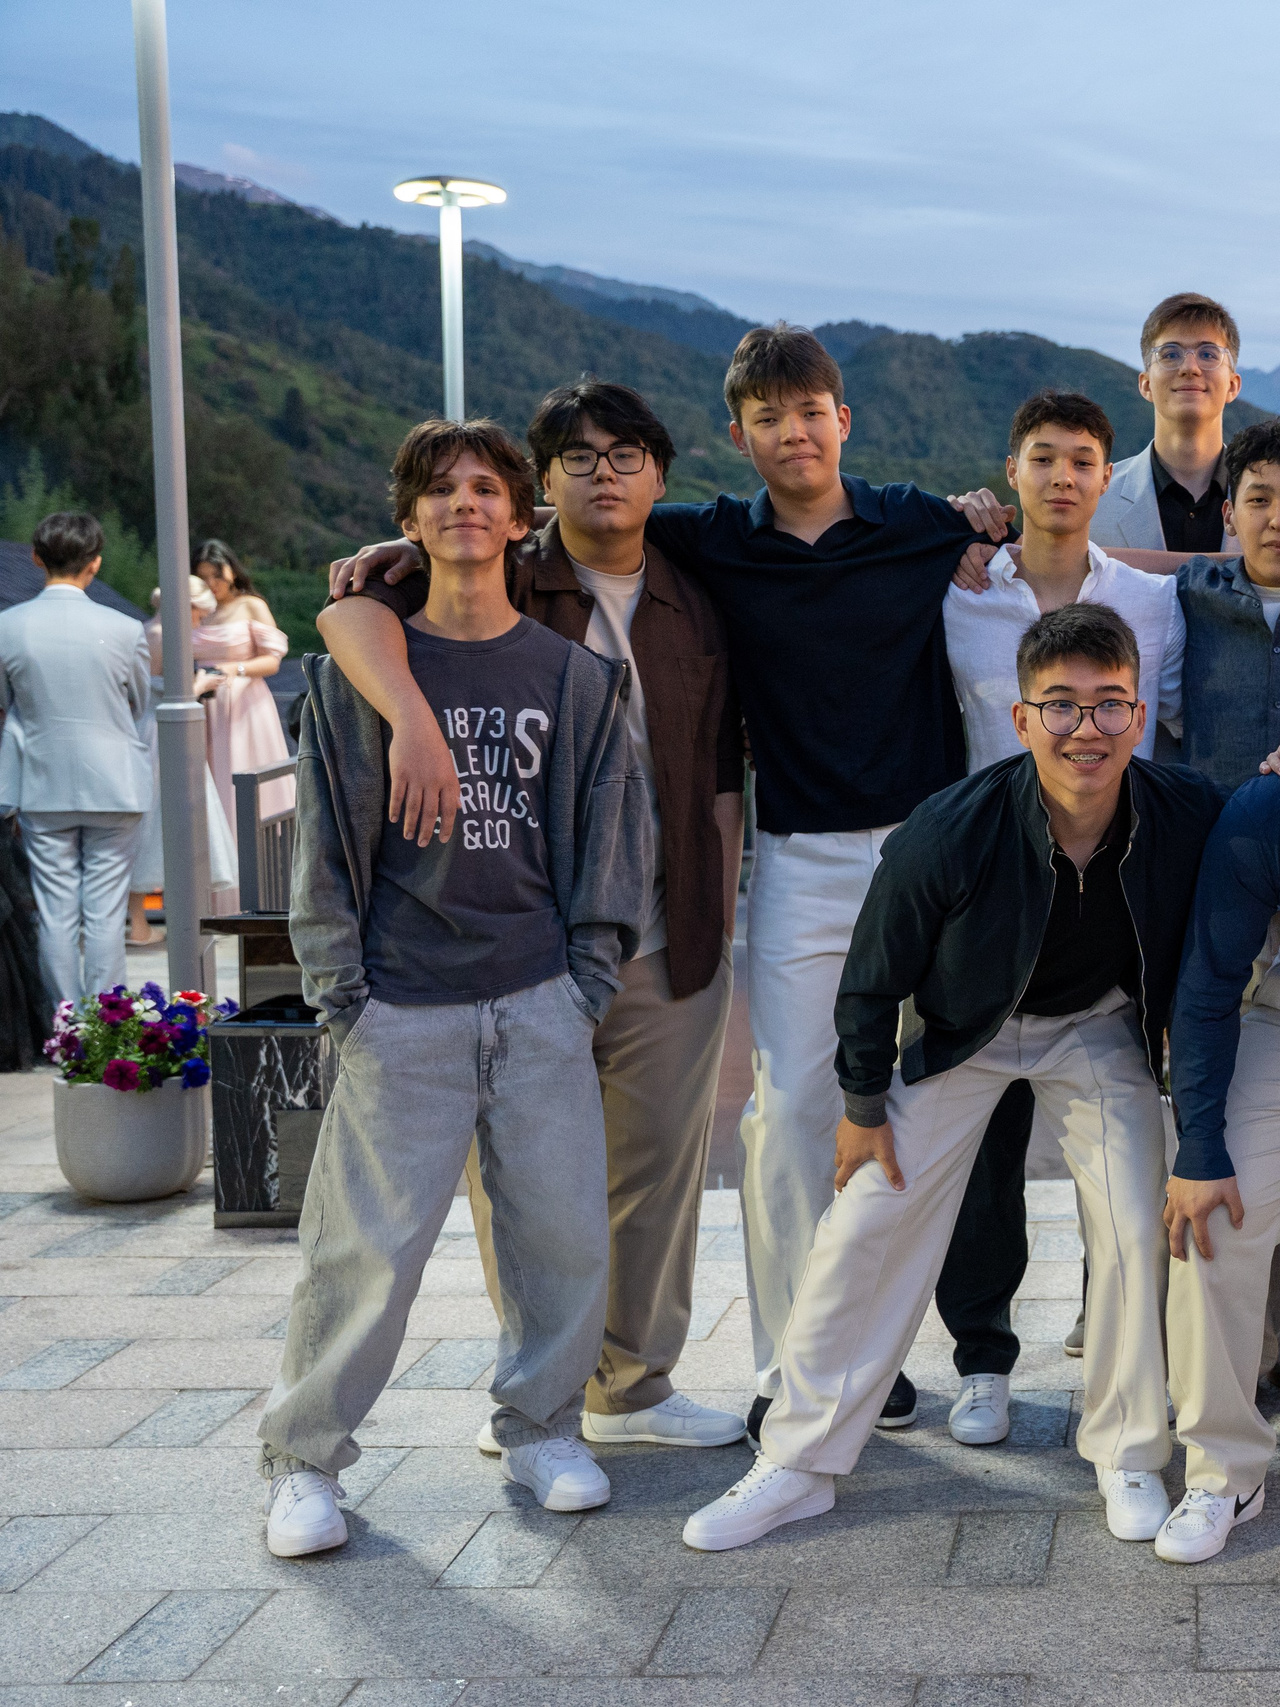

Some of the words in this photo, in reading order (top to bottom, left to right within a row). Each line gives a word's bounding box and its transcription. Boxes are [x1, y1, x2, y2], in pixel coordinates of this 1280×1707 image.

[443, 707, 506, 739] 1873
[515, 708, 549, 779] S
[463, 819, 511, 850] &CO
